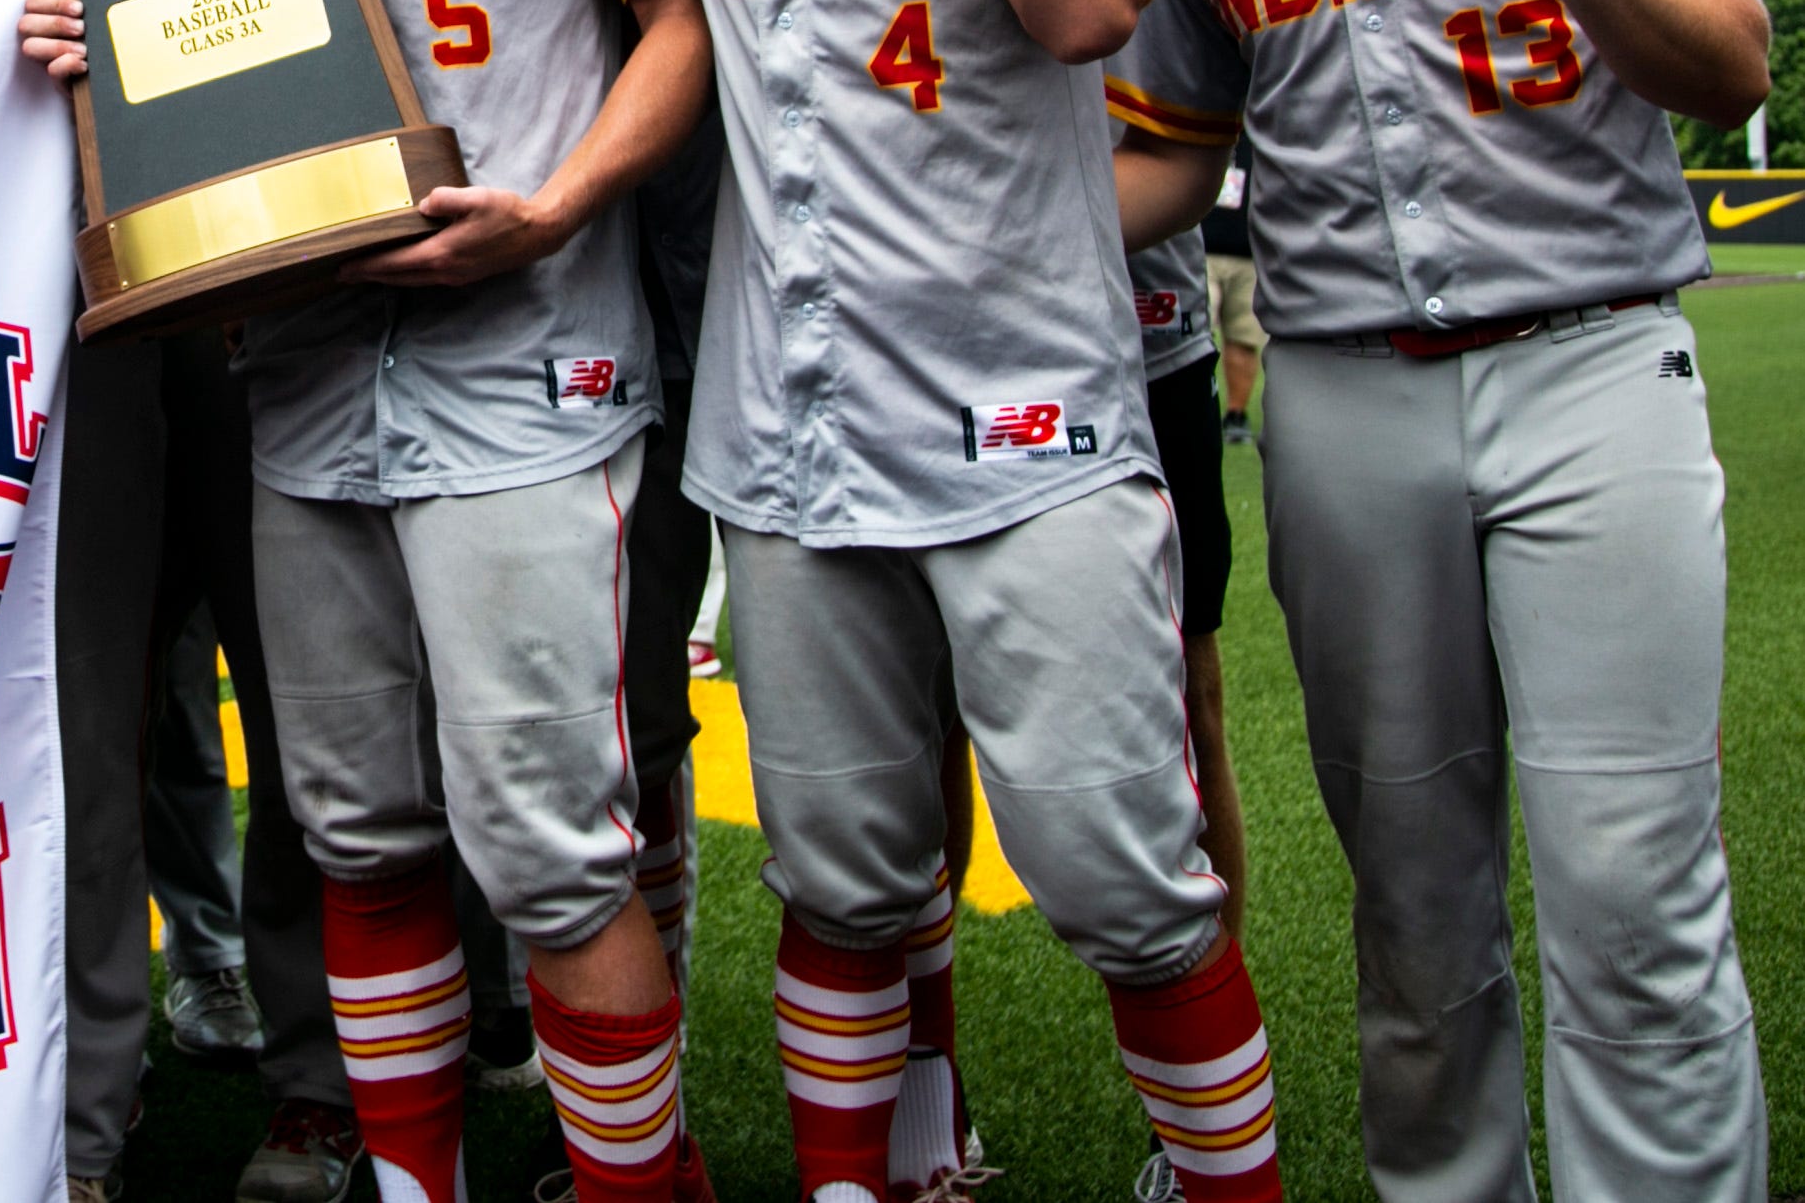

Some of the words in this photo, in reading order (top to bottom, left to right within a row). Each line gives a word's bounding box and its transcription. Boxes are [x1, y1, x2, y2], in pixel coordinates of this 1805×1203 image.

[179, 25, 235, 56] CLASS
[239, 18, 264, 39] 3A
[866, 0, 945, 114] 4
[1075, 436, 1092, 451] M
